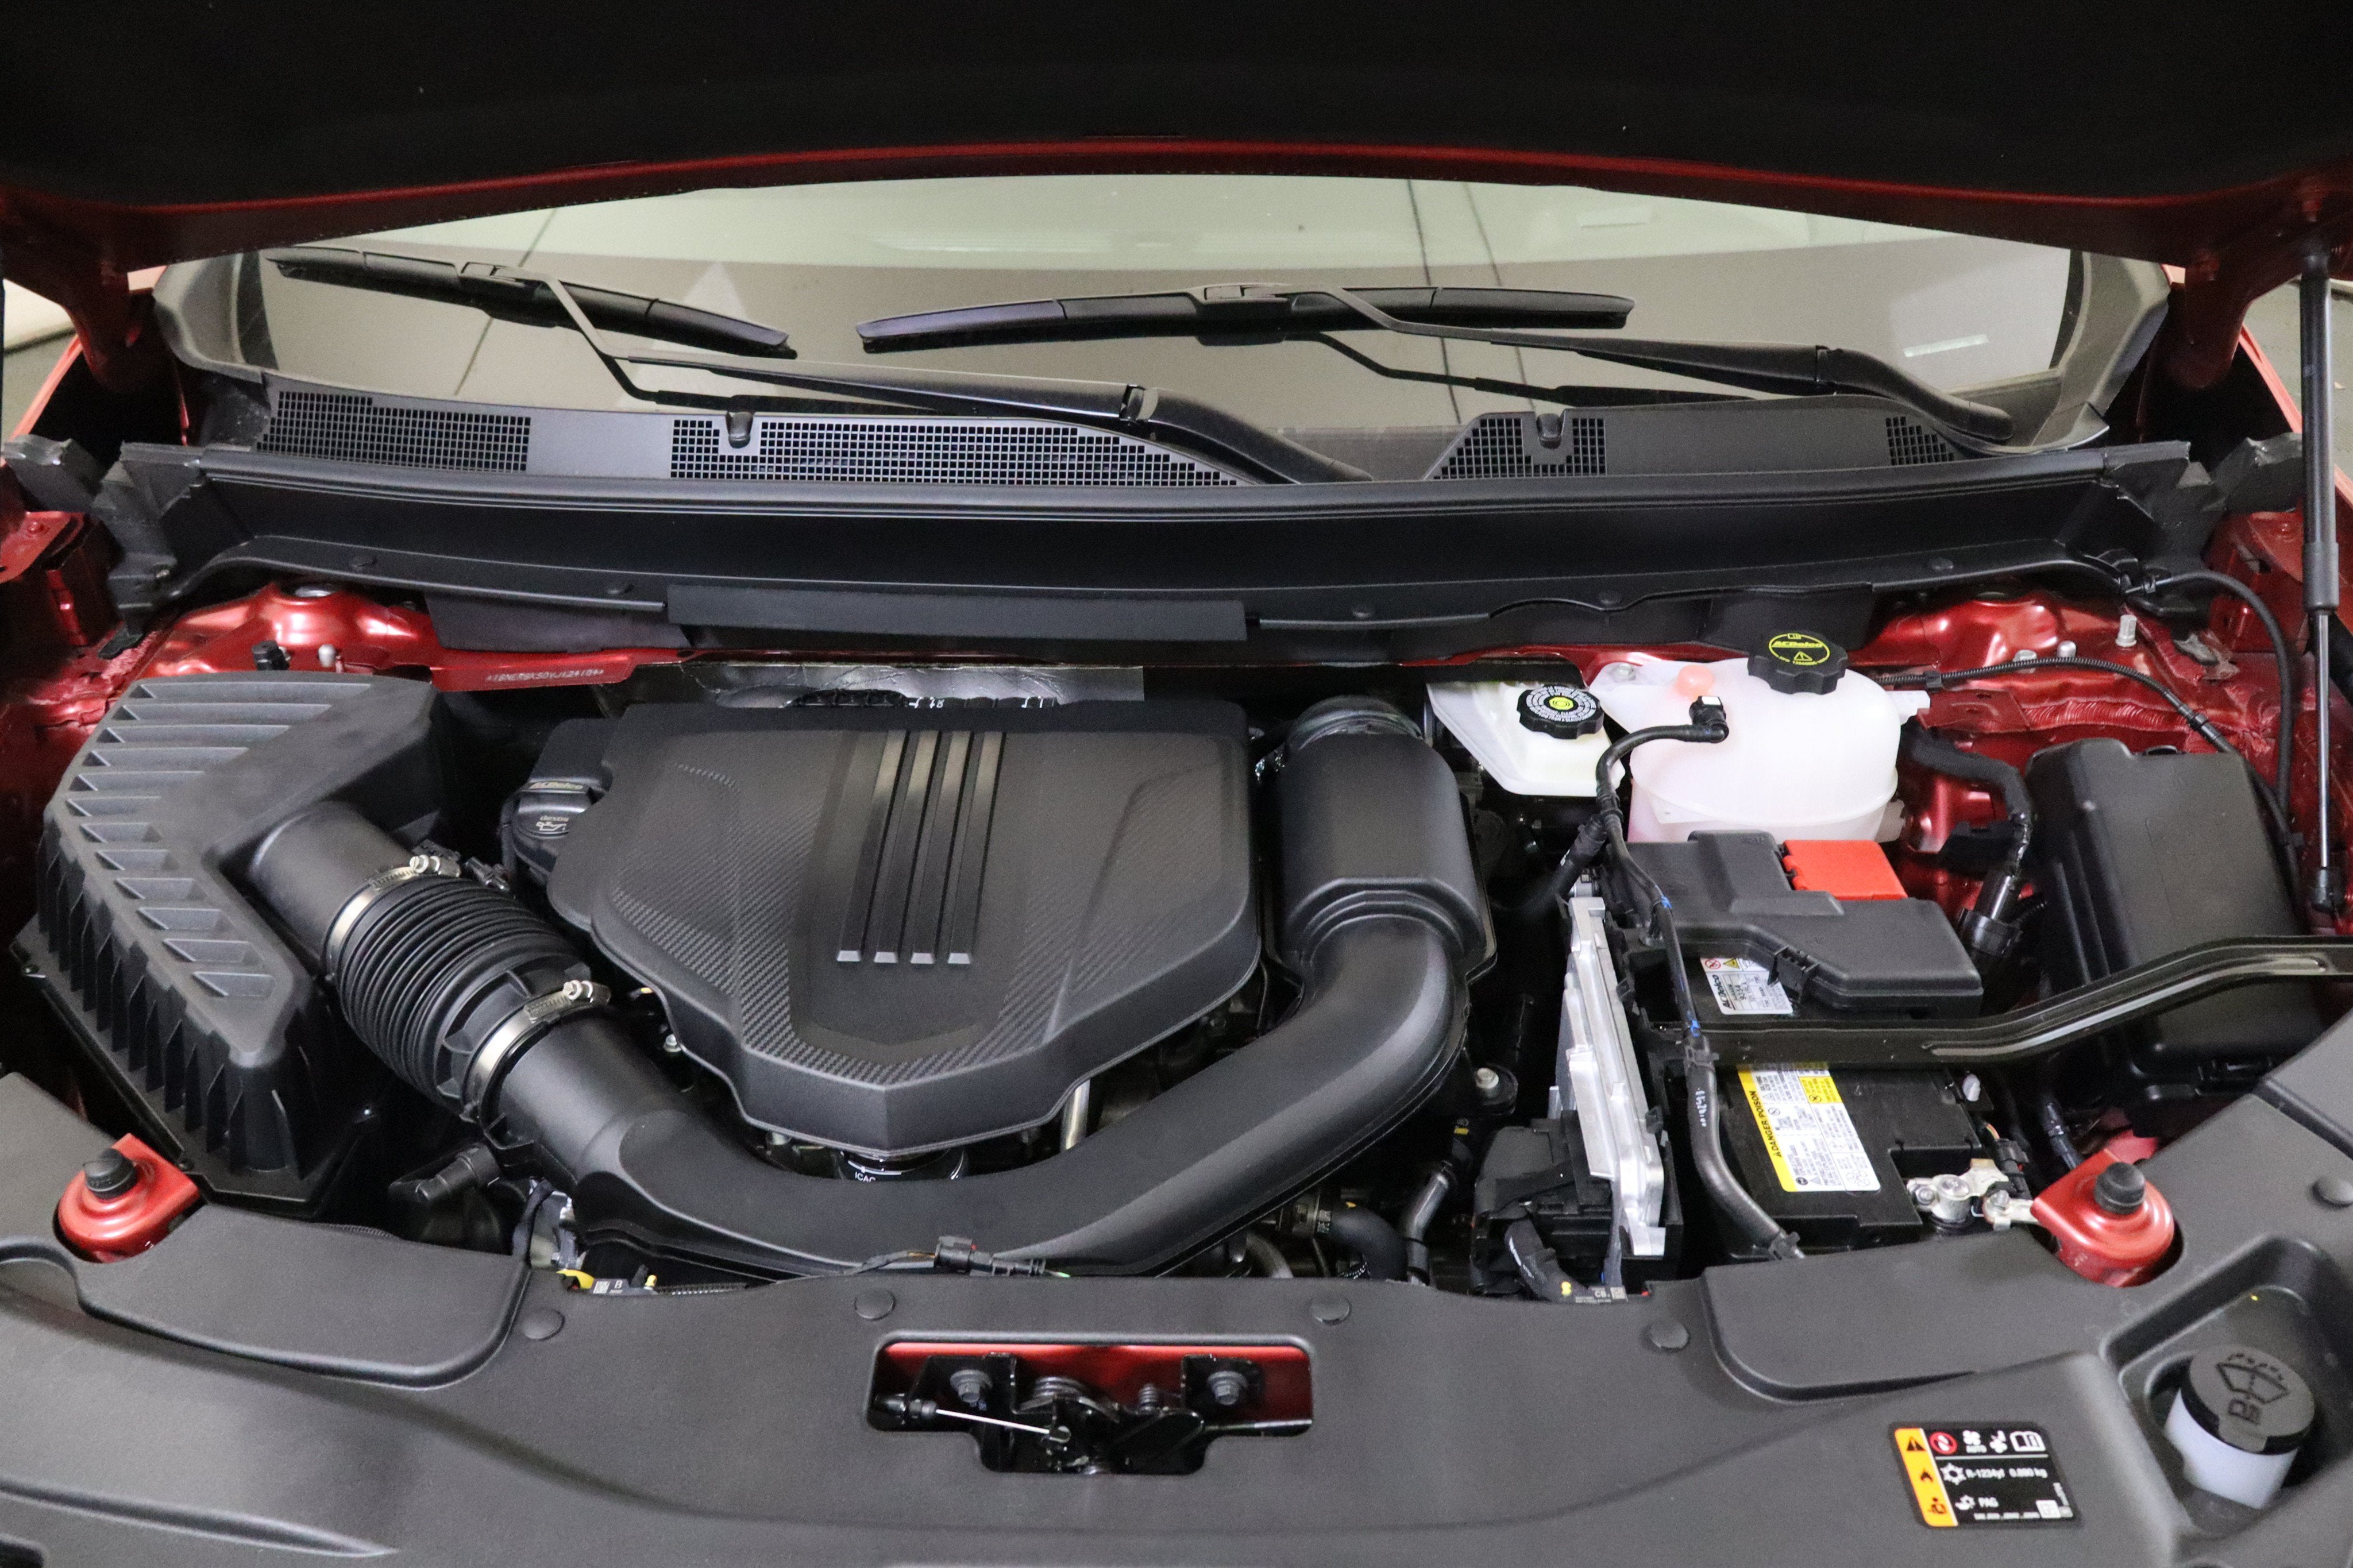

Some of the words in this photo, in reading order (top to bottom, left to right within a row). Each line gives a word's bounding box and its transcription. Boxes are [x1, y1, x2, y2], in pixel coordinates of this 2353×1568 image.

[529, 782, 584, 790] ACDelco
[1712, 975, 1732, 1009] ACDelco
[1749, 1090, 1766, 1118] POISON
[1761, 1119, 1779, 1152] DANGER
